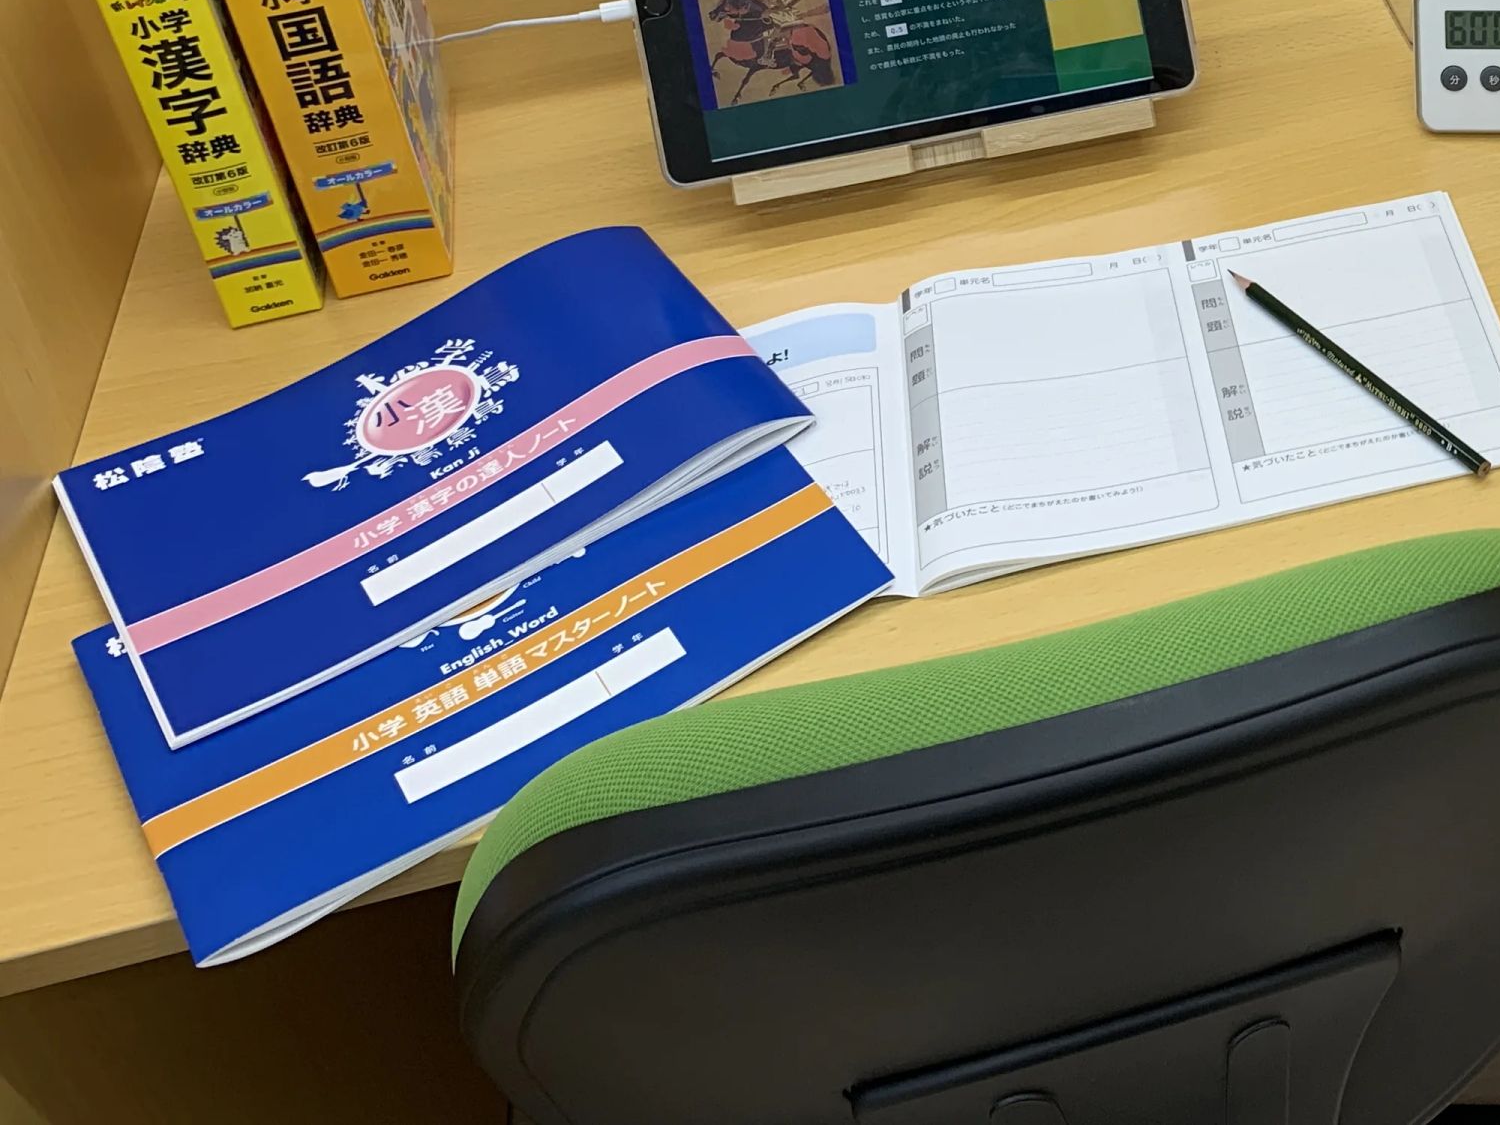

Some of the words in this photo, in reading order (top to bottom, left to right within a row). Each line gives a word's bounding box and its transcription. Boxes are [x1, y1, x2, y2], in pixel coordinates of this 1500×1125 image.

[131, 8, 192, 40] 小学
[267, 6, 355, 109] 国語
[138, 35, 228, 137] 漢字
[1450, 74, 1460, 86] 分
[1489, 74, 1500, 86] 秒
[303, 104, 365, 134] 辞典
[177, 134, 242, 165] 辞典
[315, 134, 371, 154] 改訂第6版
[191, 166, 249, 186] 改訂第6版
[326, 168, 384, 185] オールカラー
[203, 198, 263, 217] オールカラー
[1242, 233, 1272, 245] 単元名
[369, 266, 411, 282] Gakken
[959, 276, 991, 286] 単元名
[250, 299, 294, 313] Gakken
[93, 441, 205, 491] 松陰塾
[429, 458, 464, 480] Kan
[467, 447, 481, 460] Ji
[1252, 447, 1317, 470] 気づいたこと
[354, 517, 403, 549] 小学
[407, 416, 577, 521] 漢字の達人ノート
[932, 504, 1001, 528] 気づいたこと
[440, 606, 559, 675] English_Word
[613, 632, 644, 654] 学年
[352, 715, 407, 752] 小学
[413, 683, 470, 723] 英語
[474, 580, 666, 688] 単語マスターノート
[402, 744, 437, 765] 名前
